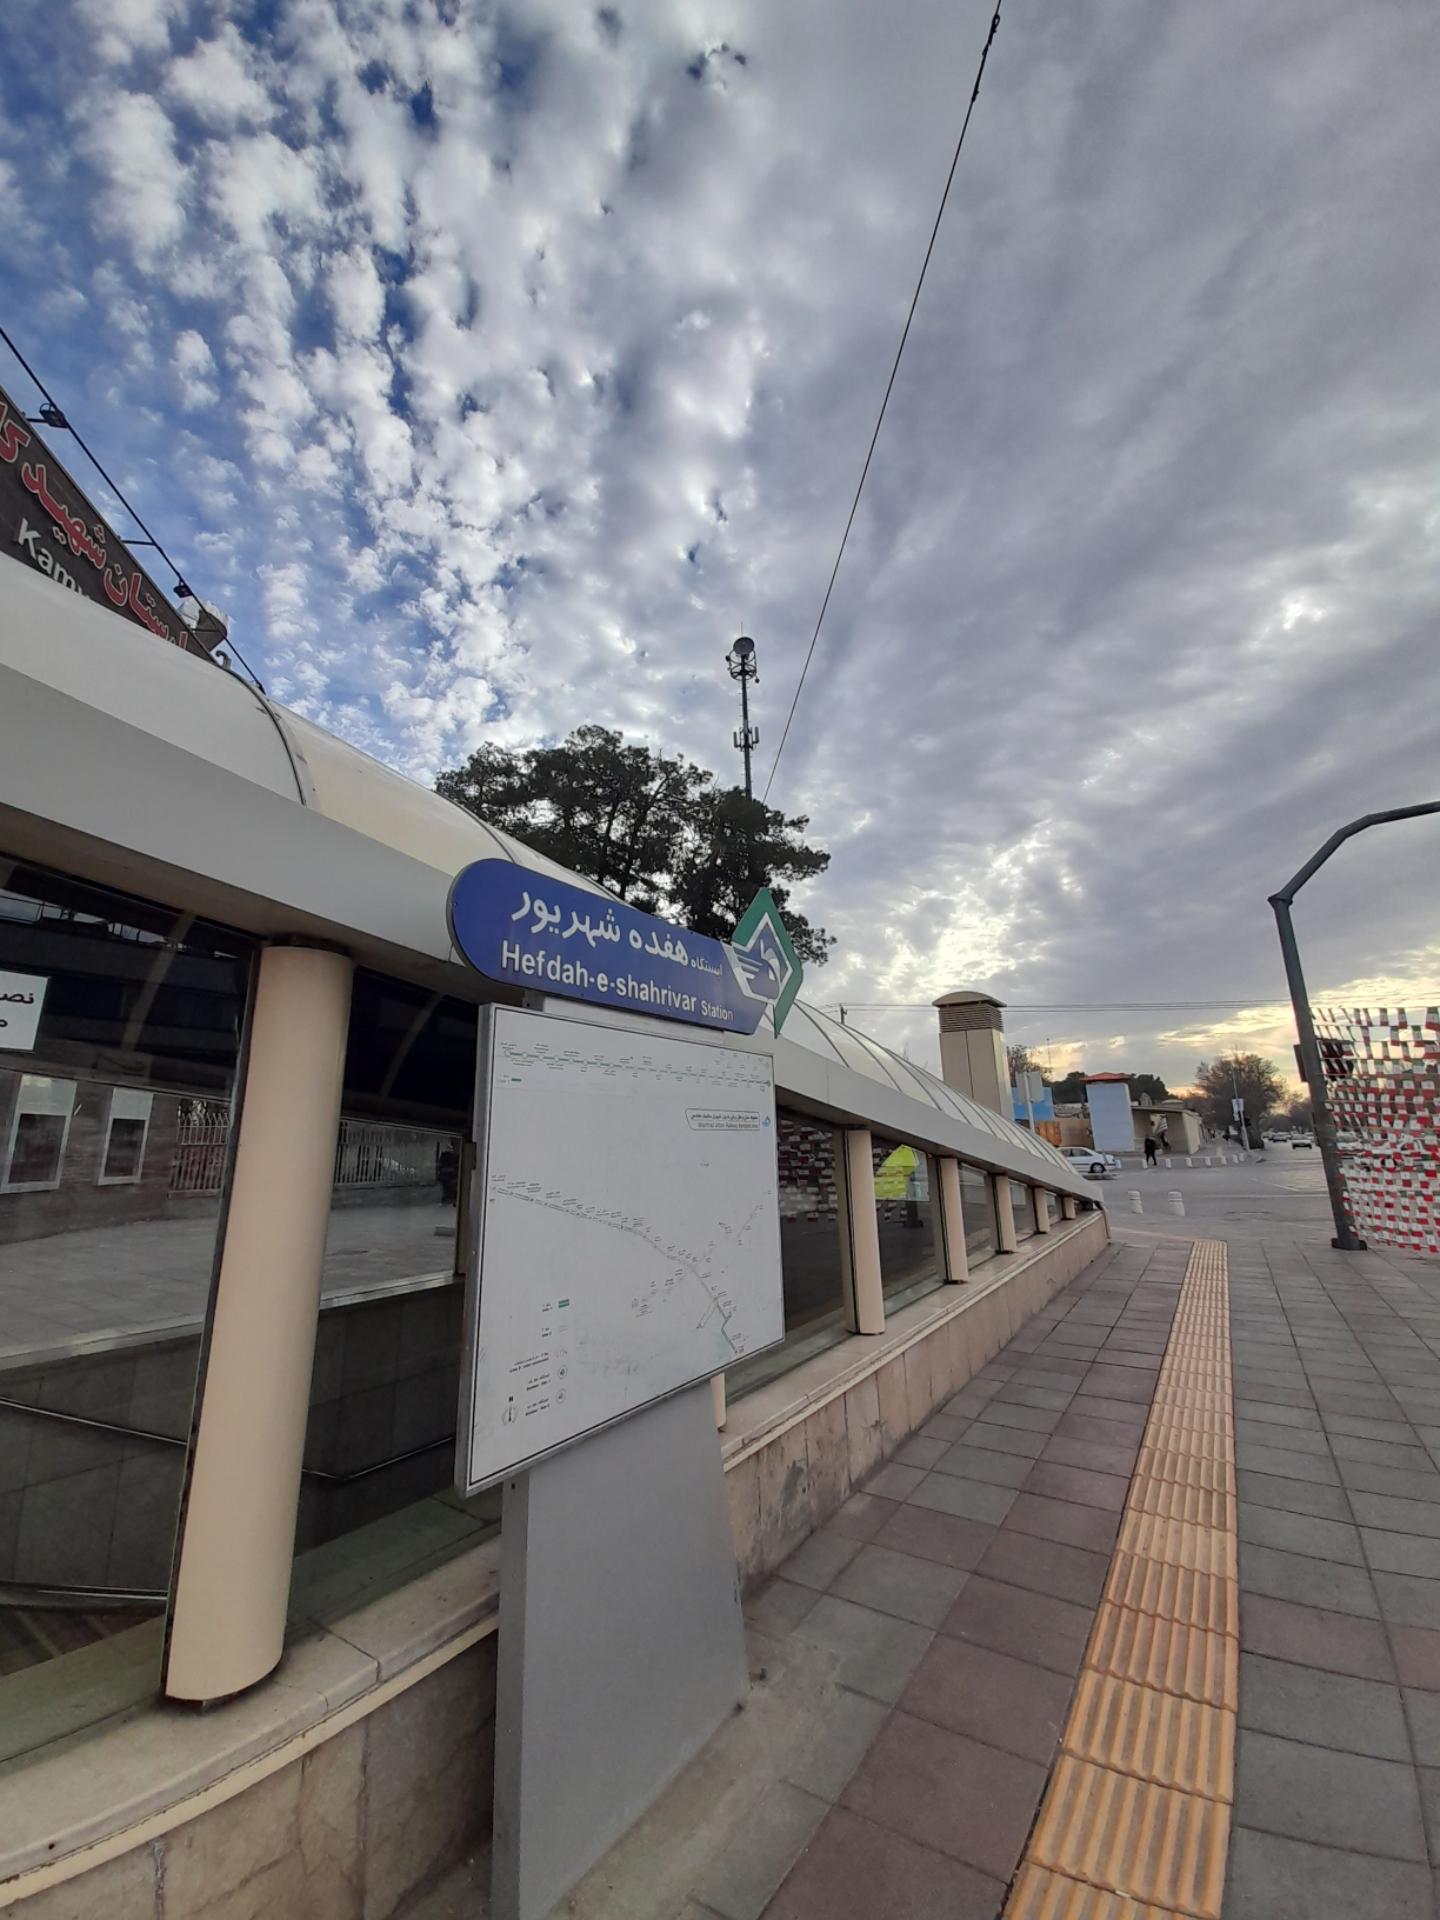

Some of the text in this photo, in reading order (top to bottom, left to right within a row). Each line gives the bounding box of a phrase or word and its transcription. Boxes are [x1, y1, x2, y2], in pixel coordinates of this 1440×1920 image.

[18, 517, 90, 599] Kam
[511, 891, 723, 977] ایستگاه هفده شهریور
[502, 940, 734, 1022] Hefdah-e-shahrivar Station
